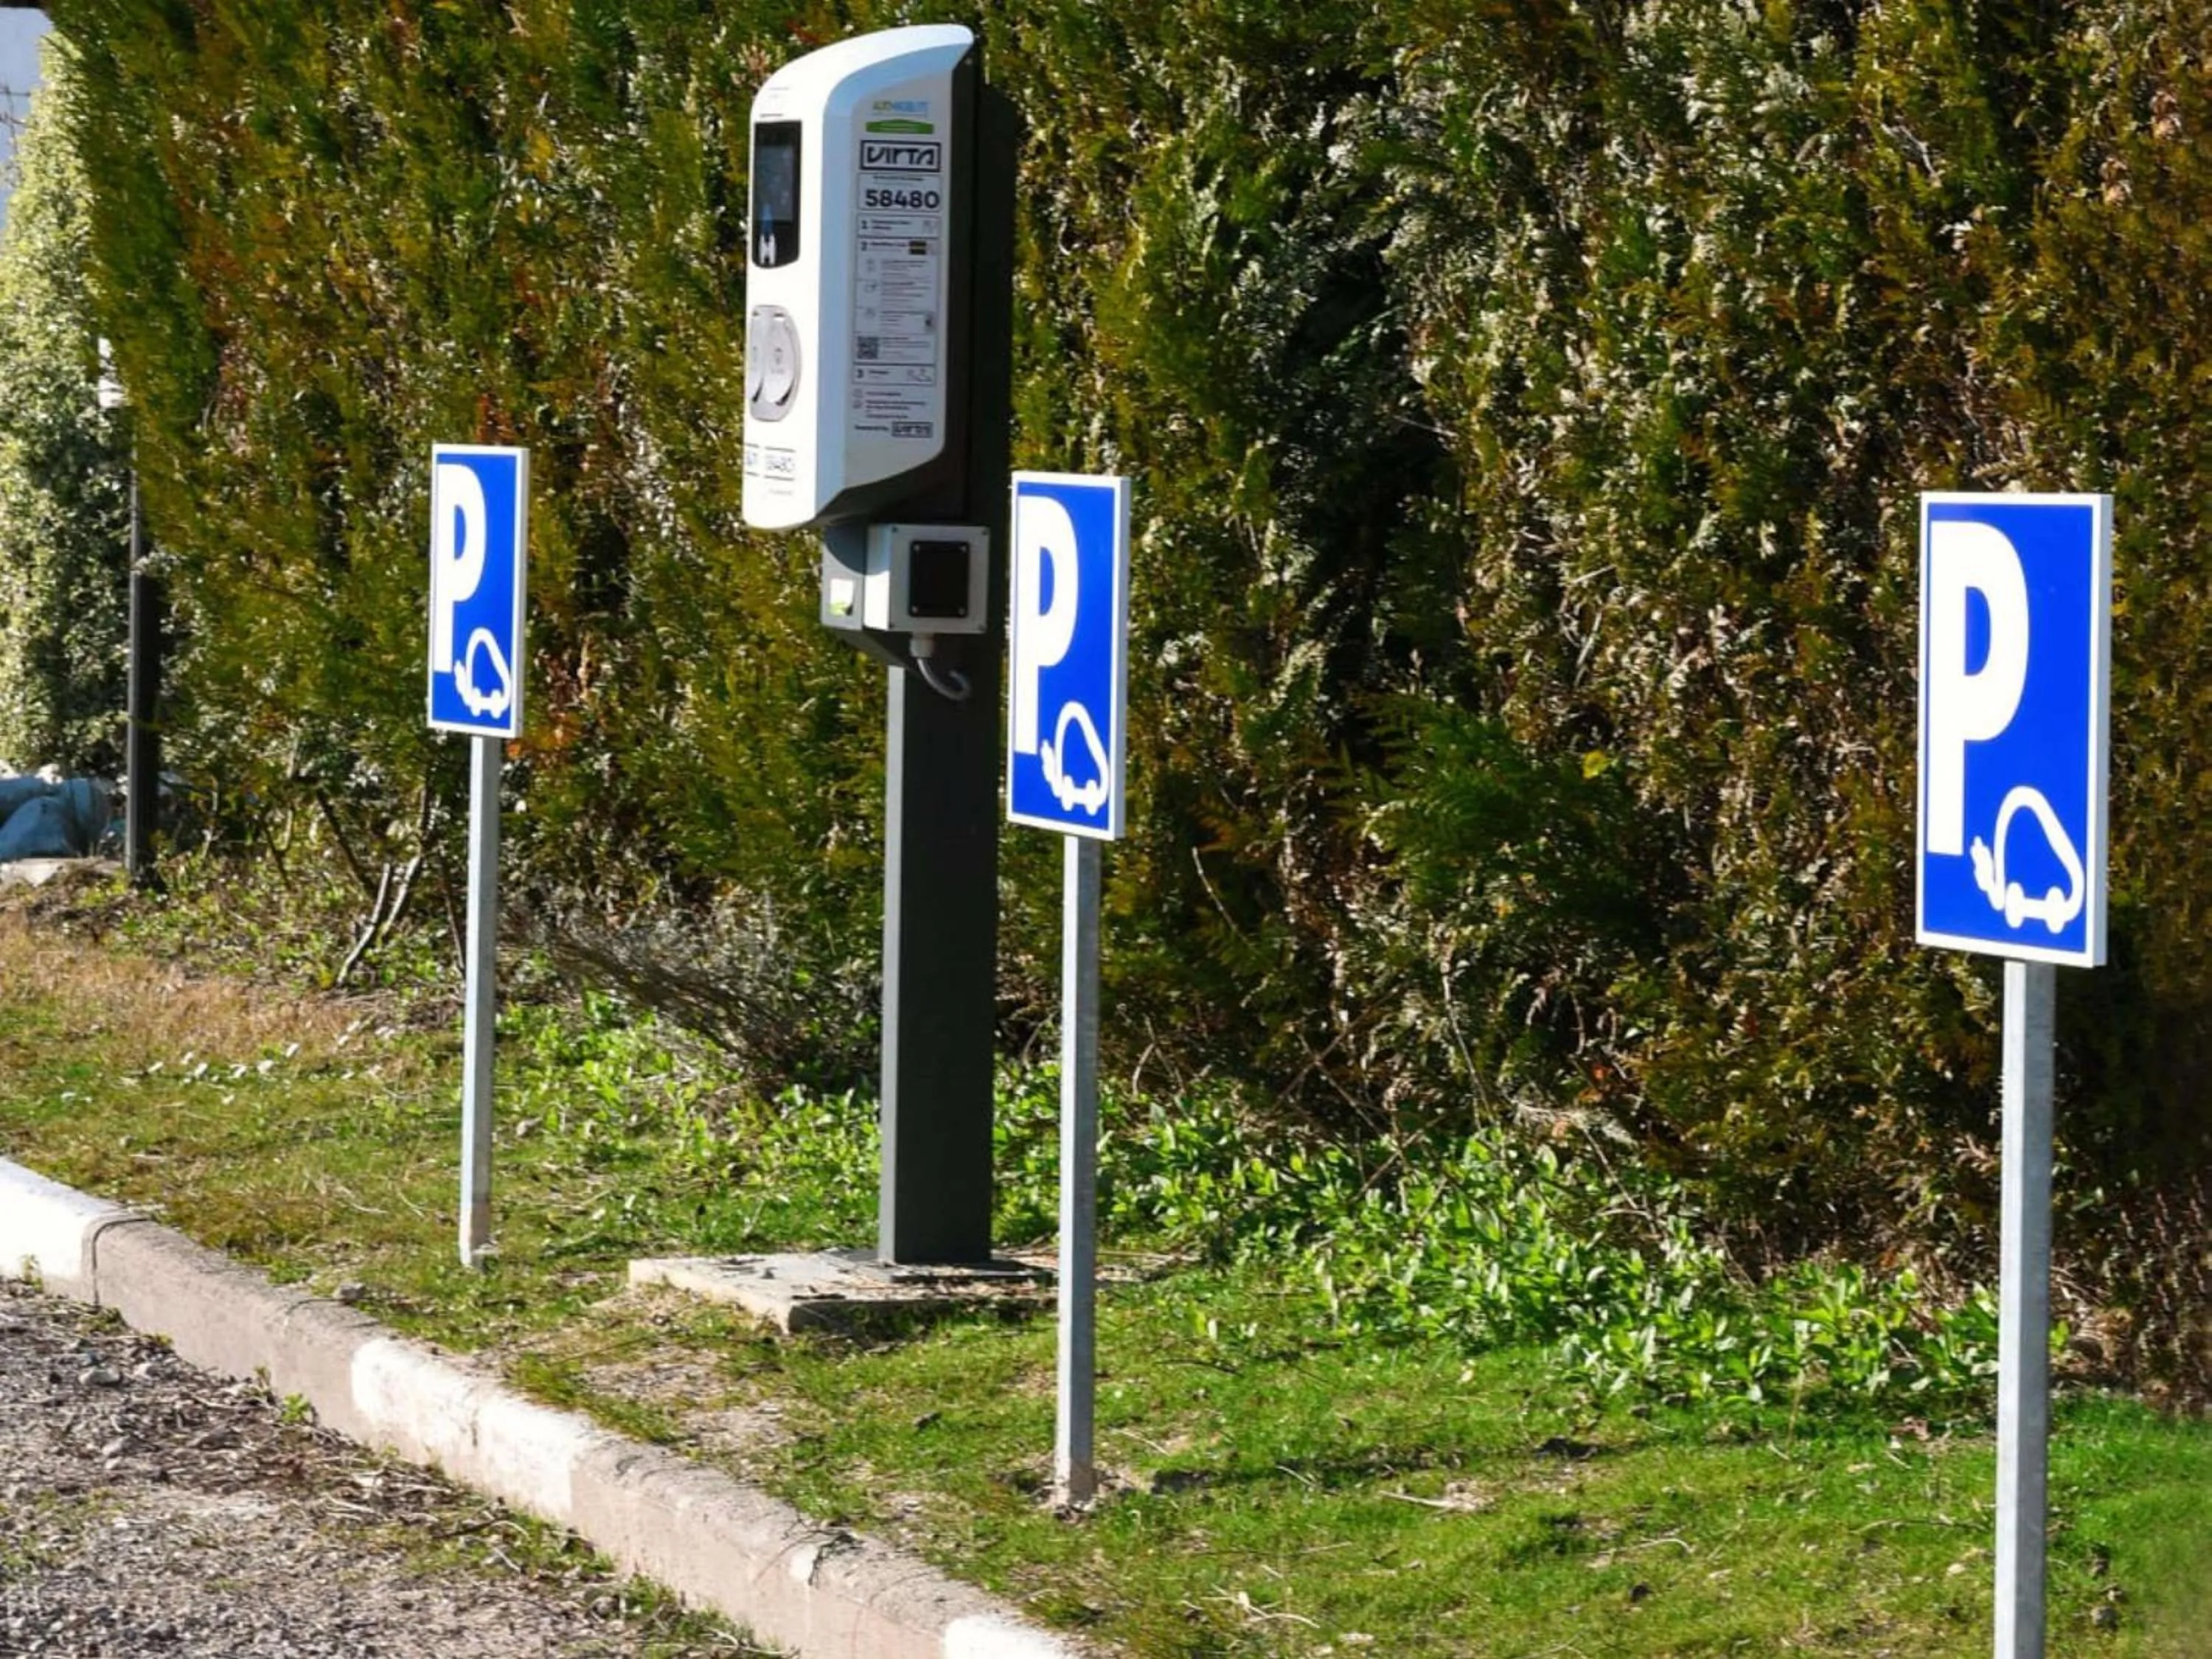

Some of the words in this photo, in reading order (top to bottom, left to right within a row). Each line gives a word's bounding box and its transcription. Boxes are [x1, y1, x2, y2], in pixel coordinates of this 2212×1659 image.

[865, 189, 939, 209] 58480
[433, 463, 487, 673] P
[1014, 495, 1079, 755] P
[1927, 521, 2030, 856] P
